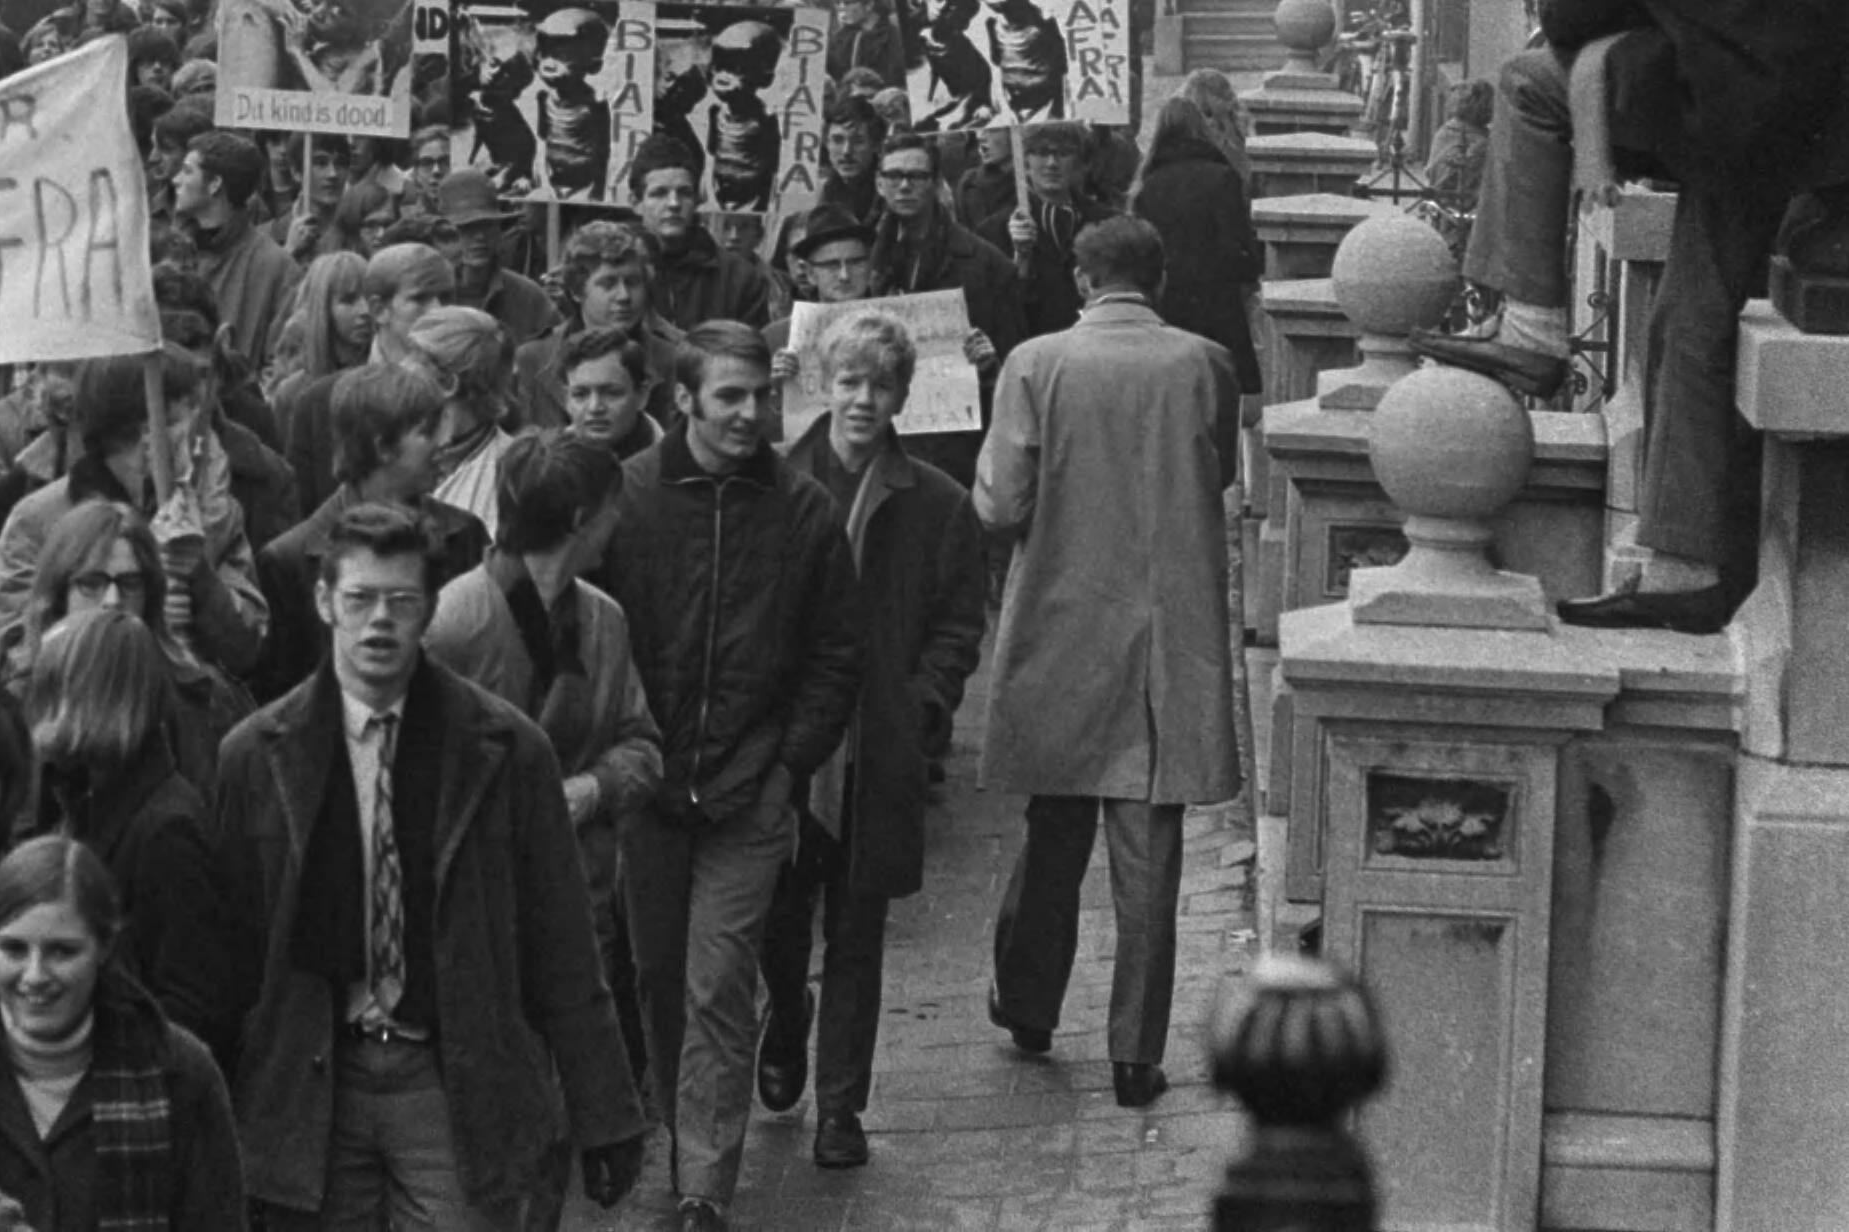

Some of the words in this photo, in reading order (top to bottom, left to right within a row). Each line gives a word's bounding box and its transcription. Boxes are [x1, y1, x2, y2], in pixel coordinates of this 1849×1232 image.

[271, 95, 312, 123] kind
[315, 102, 331, 124] is
[779, 25, 824, 193] BIAFRA
